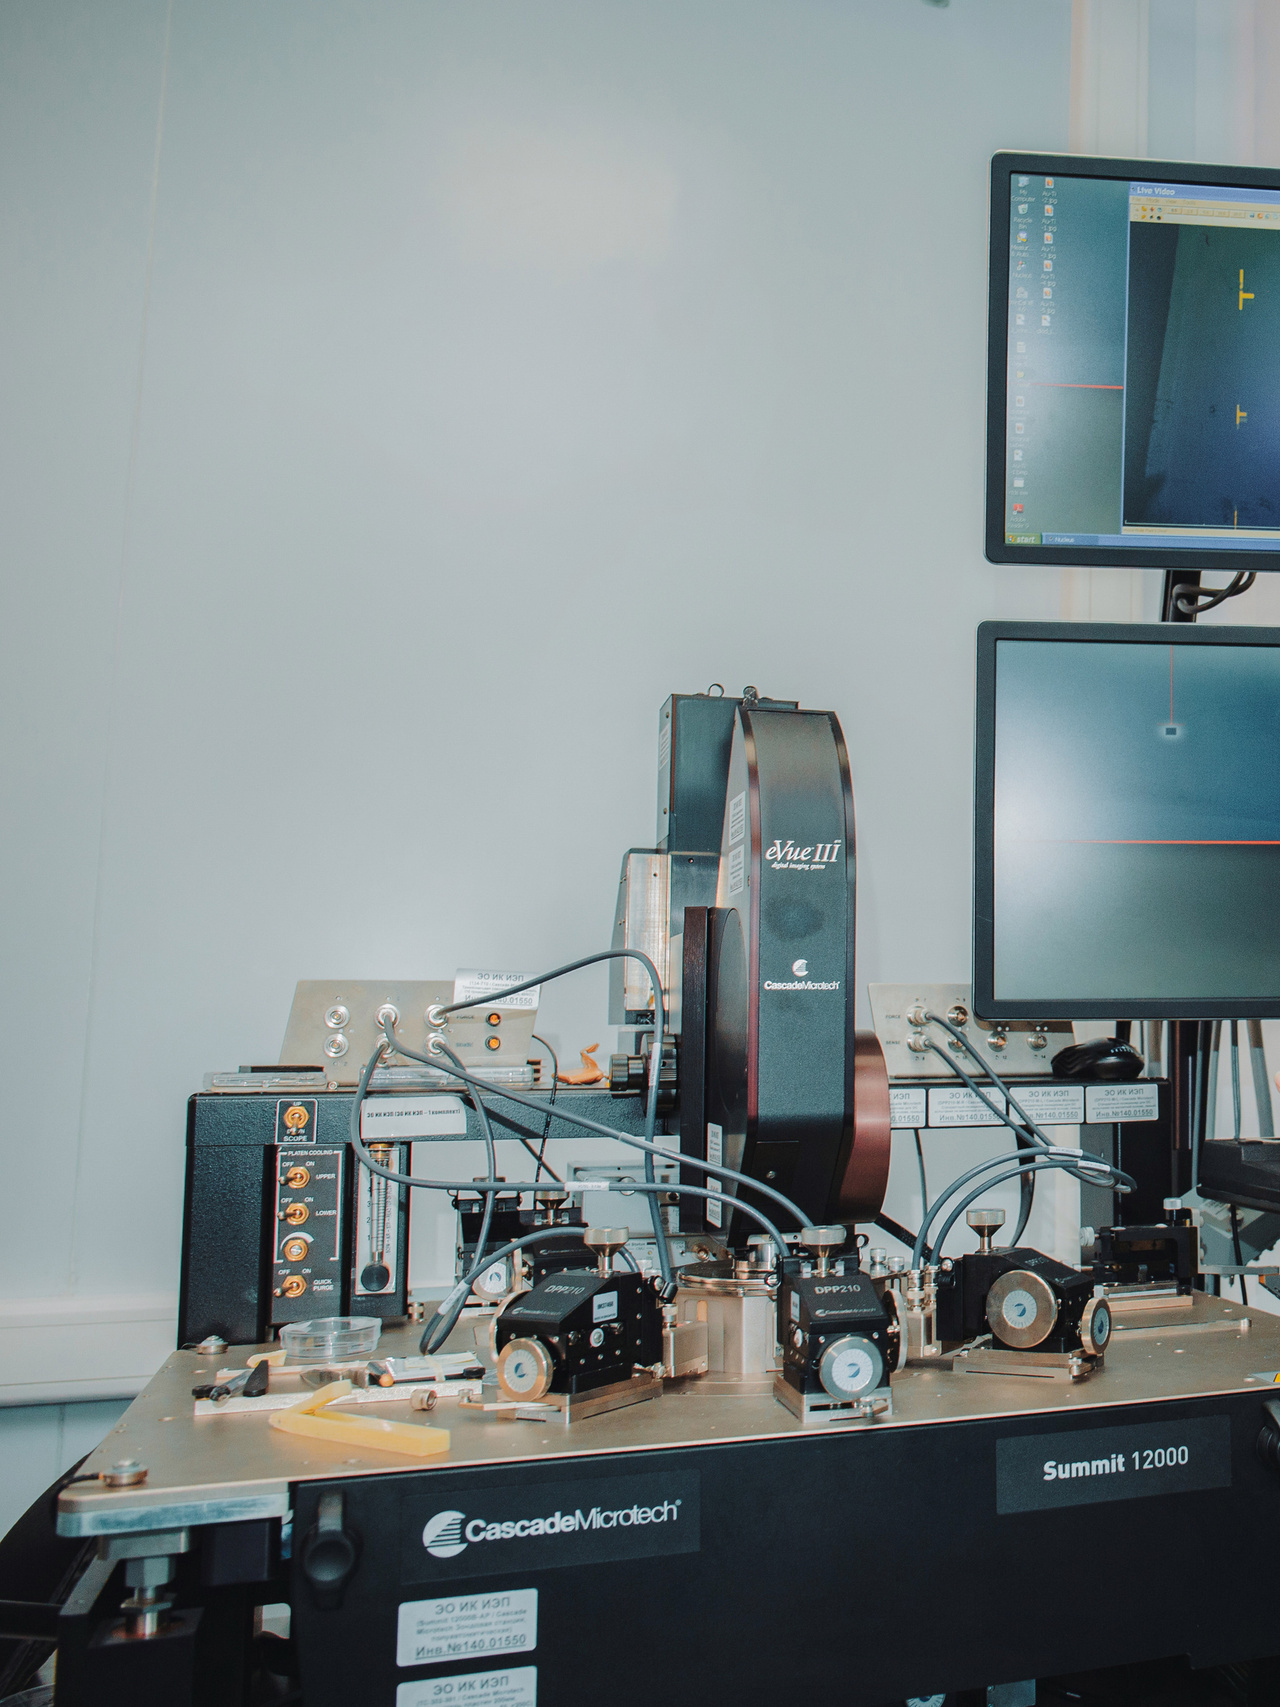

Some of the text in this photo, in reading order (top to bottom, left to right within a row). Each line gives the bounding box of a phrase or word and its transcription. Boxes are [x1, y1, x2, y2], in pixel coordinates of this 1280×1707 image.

[1137, 186, 1176, 196] Live Video
[1016, 535, 1036, 544] start
[765, 839, 842, 863] eVue III
[477, 972, 524, 982] ЭО ИК ИЭП
[544, 1284, 585, 1295] DPP210
[814, 1284, 861, 1295] DPP210
[1043, 1445, 1189, 1481] Summit 12000
[435, 1597, 511, 1615] ЭО ИК ИЭП
[433, 1675, 509, 1696] ЭО ИК ИЭП
